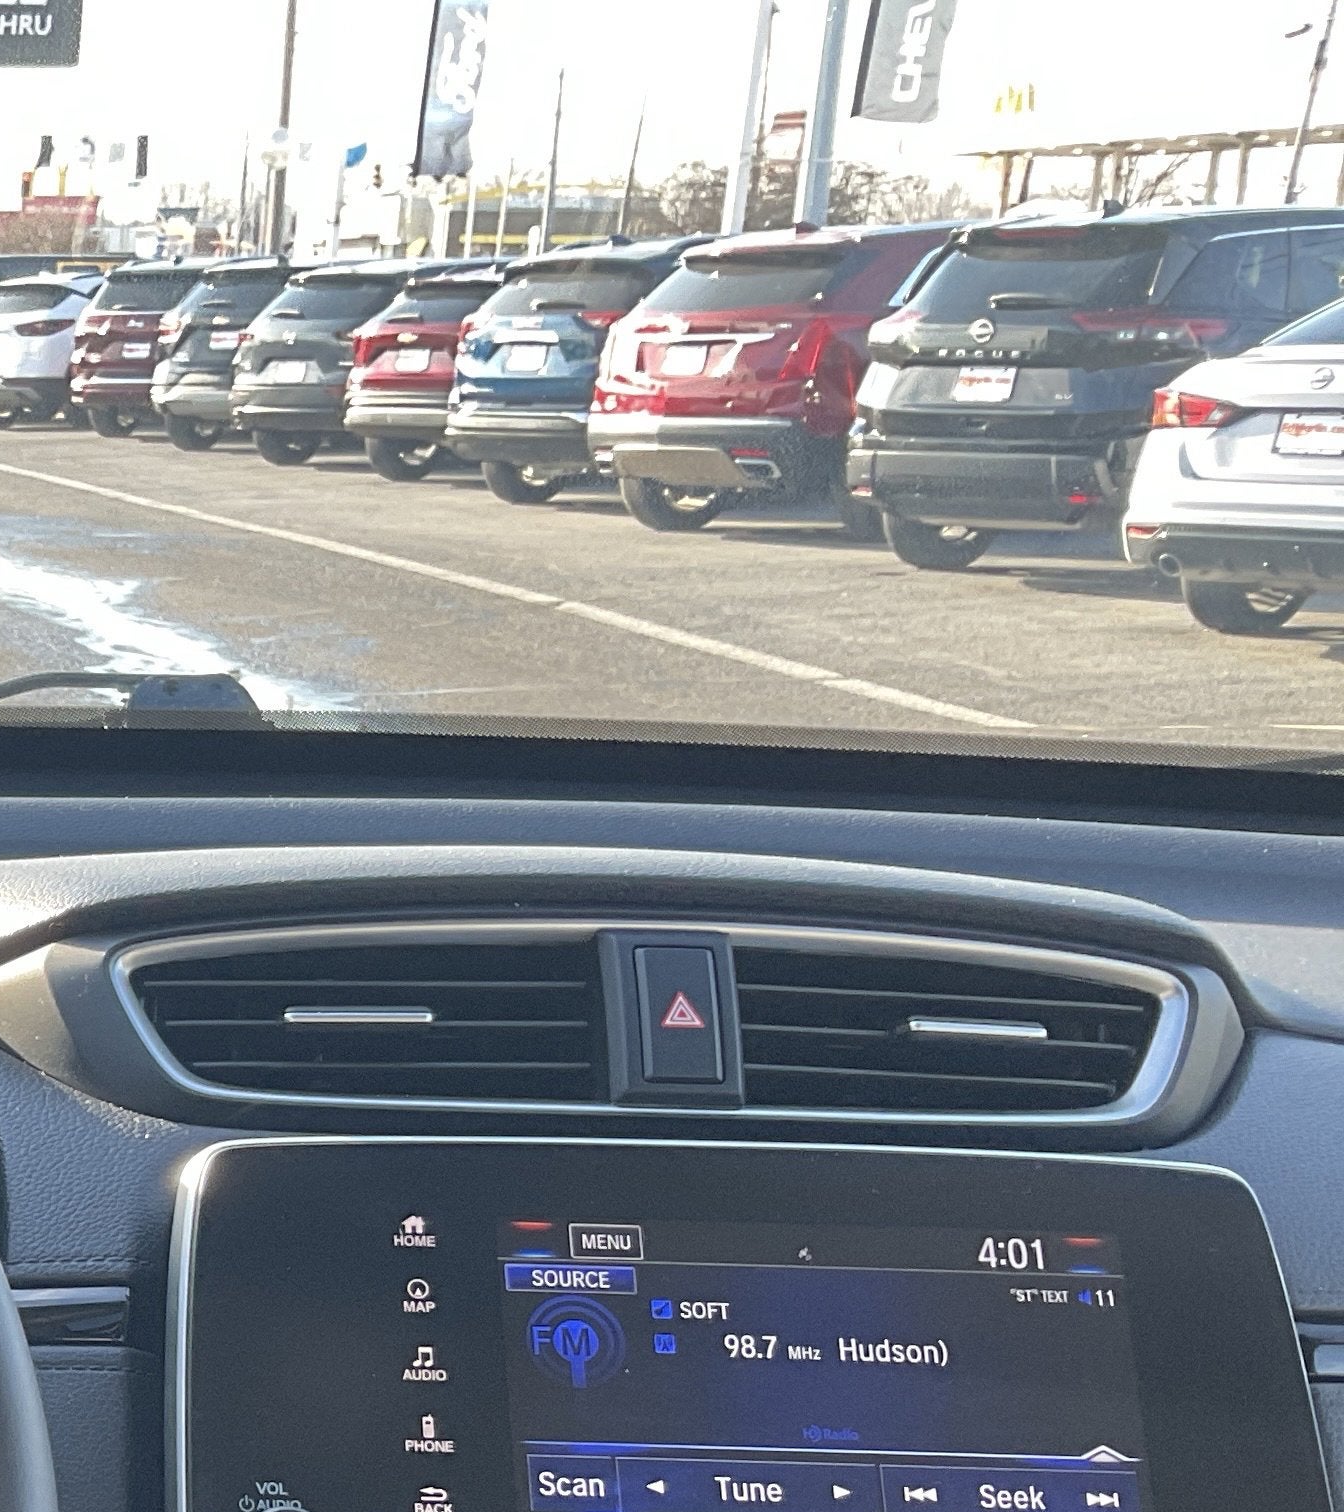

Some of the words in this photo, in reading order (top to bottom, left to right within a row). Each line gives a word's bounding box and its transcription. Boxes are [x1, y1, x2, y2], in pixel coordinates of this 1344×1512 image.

[436, 7, 487, 114] Ford
[393, 1235, 436, 1247] HOME
[581, 1233, 632, 1251] MENU
[977, 1237, 1047, 1271] 4:01
[531, 1269, 611, 1289] SOURCE
[1040, 1290, 1069, 1303] TEXT
[1096, 1290, 1114, 1306] 11
[403, 1301, 435, 1313] MAP
[679, 1302, 730, 1320] SOFT
[723, 1334, 779, 1360] 98.7
[787, 1344, 821, 1362] MHz
[837, 1337, 950, 1367] Hudson)
[402, 1369, 447, 1381] AUDIO
[405, 1440, 454, 1453] PHONE
[255, 1482, 288, 1495] VOL
[538, 1472, 605, 1499] Scan
[715, 1476, 784, 1503] Tune
[980, 1483, 1047, 1511] Seek
